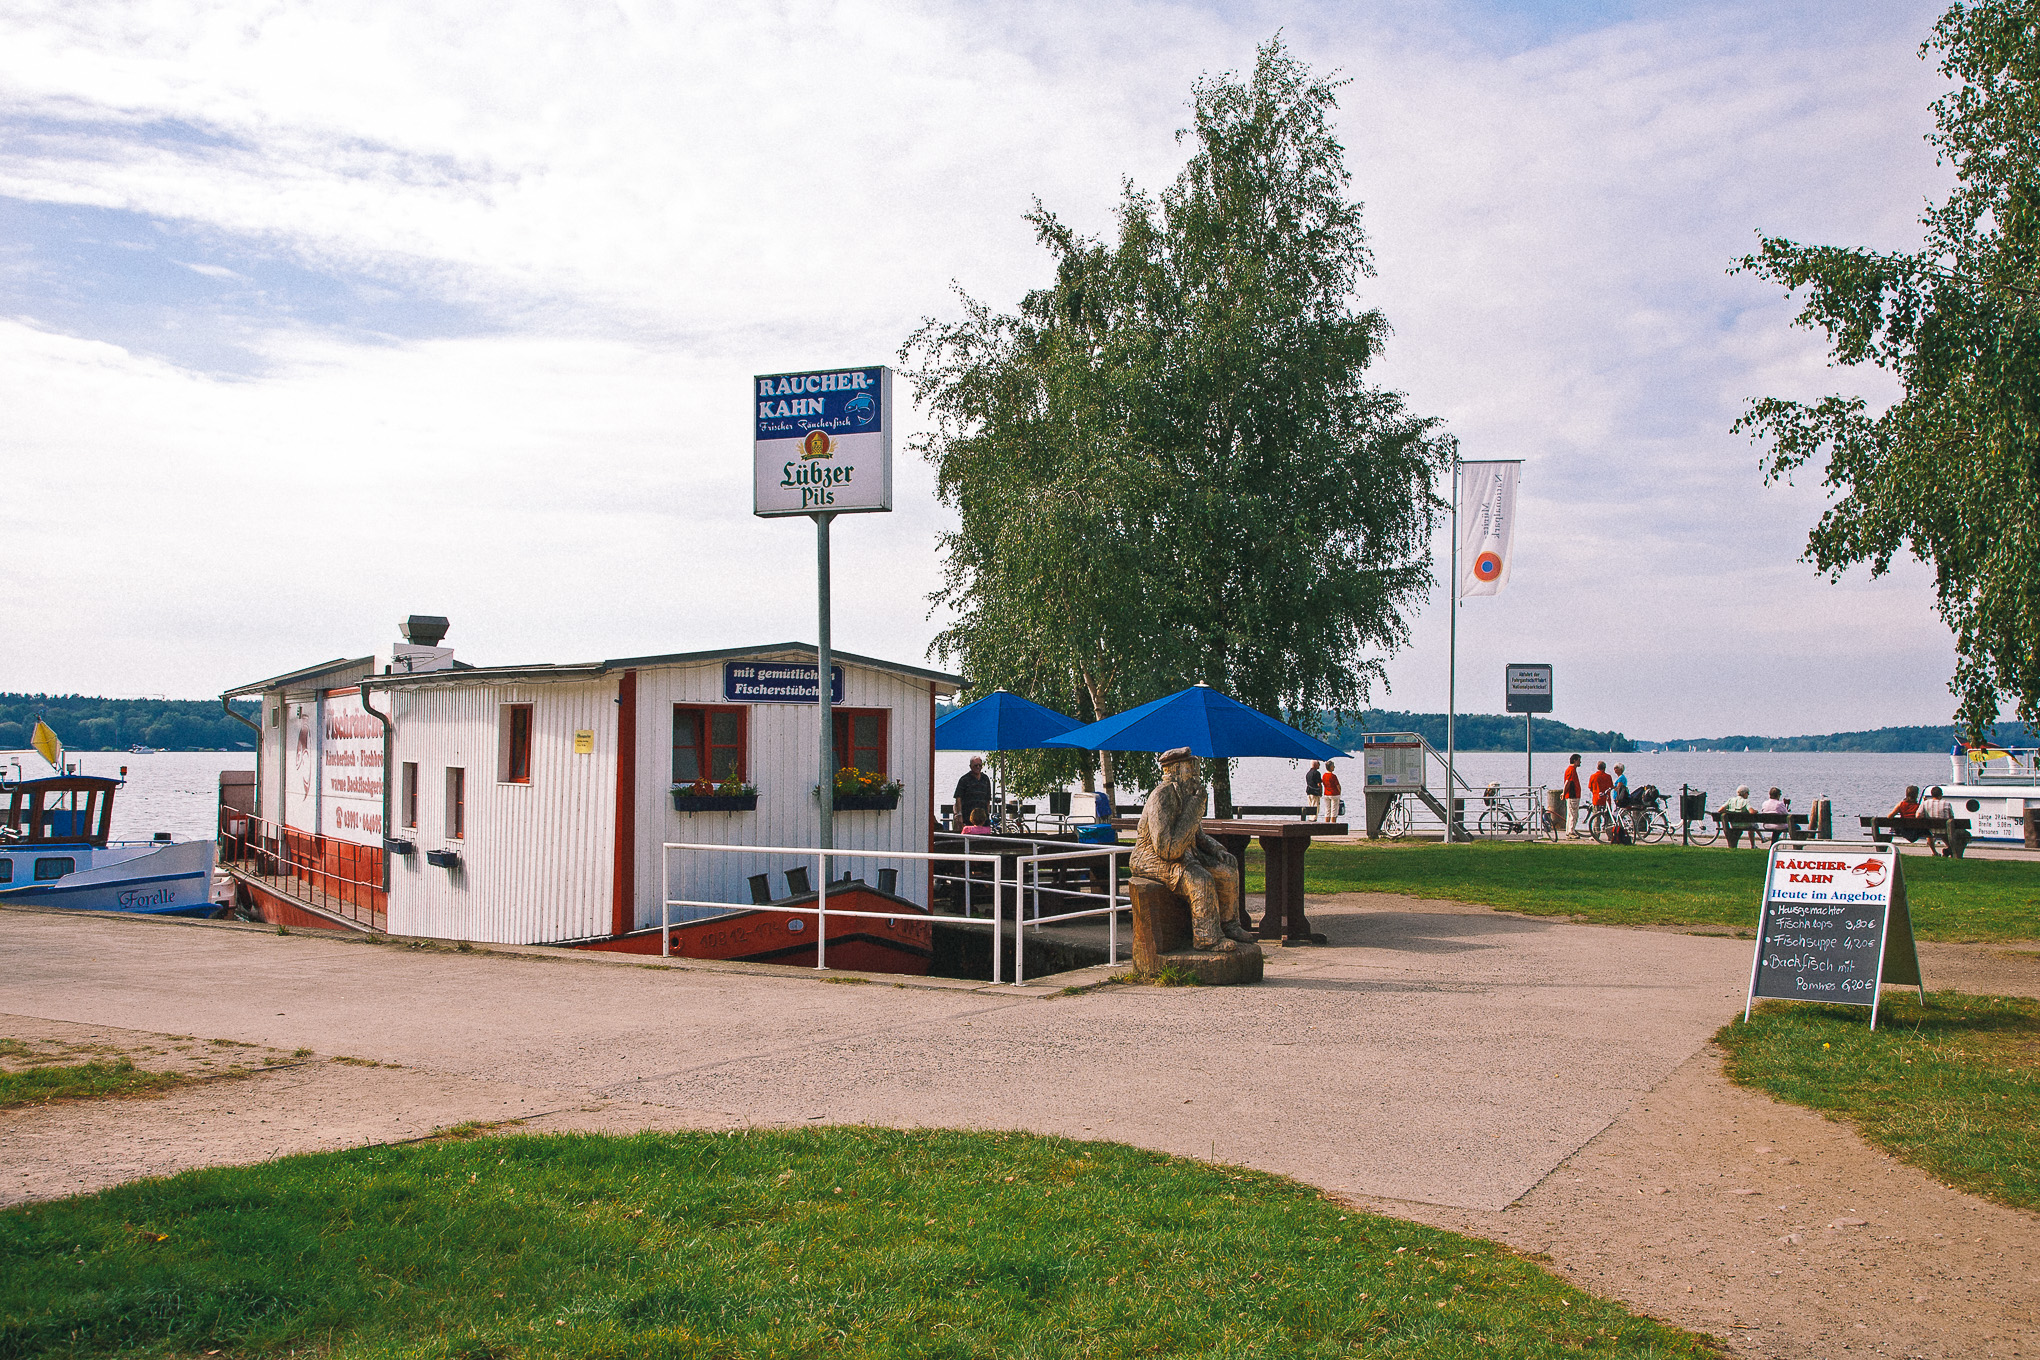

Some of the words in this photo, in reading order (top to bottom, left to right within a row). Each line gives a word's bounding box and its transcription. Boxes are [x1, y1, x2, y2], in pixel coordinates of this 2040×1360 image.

[759, 372, 875, 397] RÄUCHER-
[759, 397, 826, 419] KAHN
[759, 421, 793, 432] Frischer
[797, 417, 851, 431] Räucherfisch
[780, 461, 855, 488] Lübzer
[801, 487, 835, 509] Pils
[733, 666, 755, 678] mit
[757, 668, 836, 681] gemütlichn
[734, 683, 834, 697] Fischerstübch
[326, 749, 356, 767] Räucherfisch
[331, 778, 346, 792] warme
[1775, 858, 1852, 871] RÄUCHER-
[1789, 873, 1834, 884] KAHN
[118, 889, 175, 907] Forelle
[1771, 889, 1808, 900] Heute
[1811, 890, 1827, 900] im
[1830, 890, 1886, 903] Angebot:
[1777, 905, 1846, 917] Hausgemachter
[1775, 916, 1834, 931] Fischklops
[1773, 933, 1838, 952] Fischsuppe
[1769, 953, 1834, 973] Backfisch
[1837, 959, 1856, 973] mit
[1795, 976, 1836, 991] Pommes
